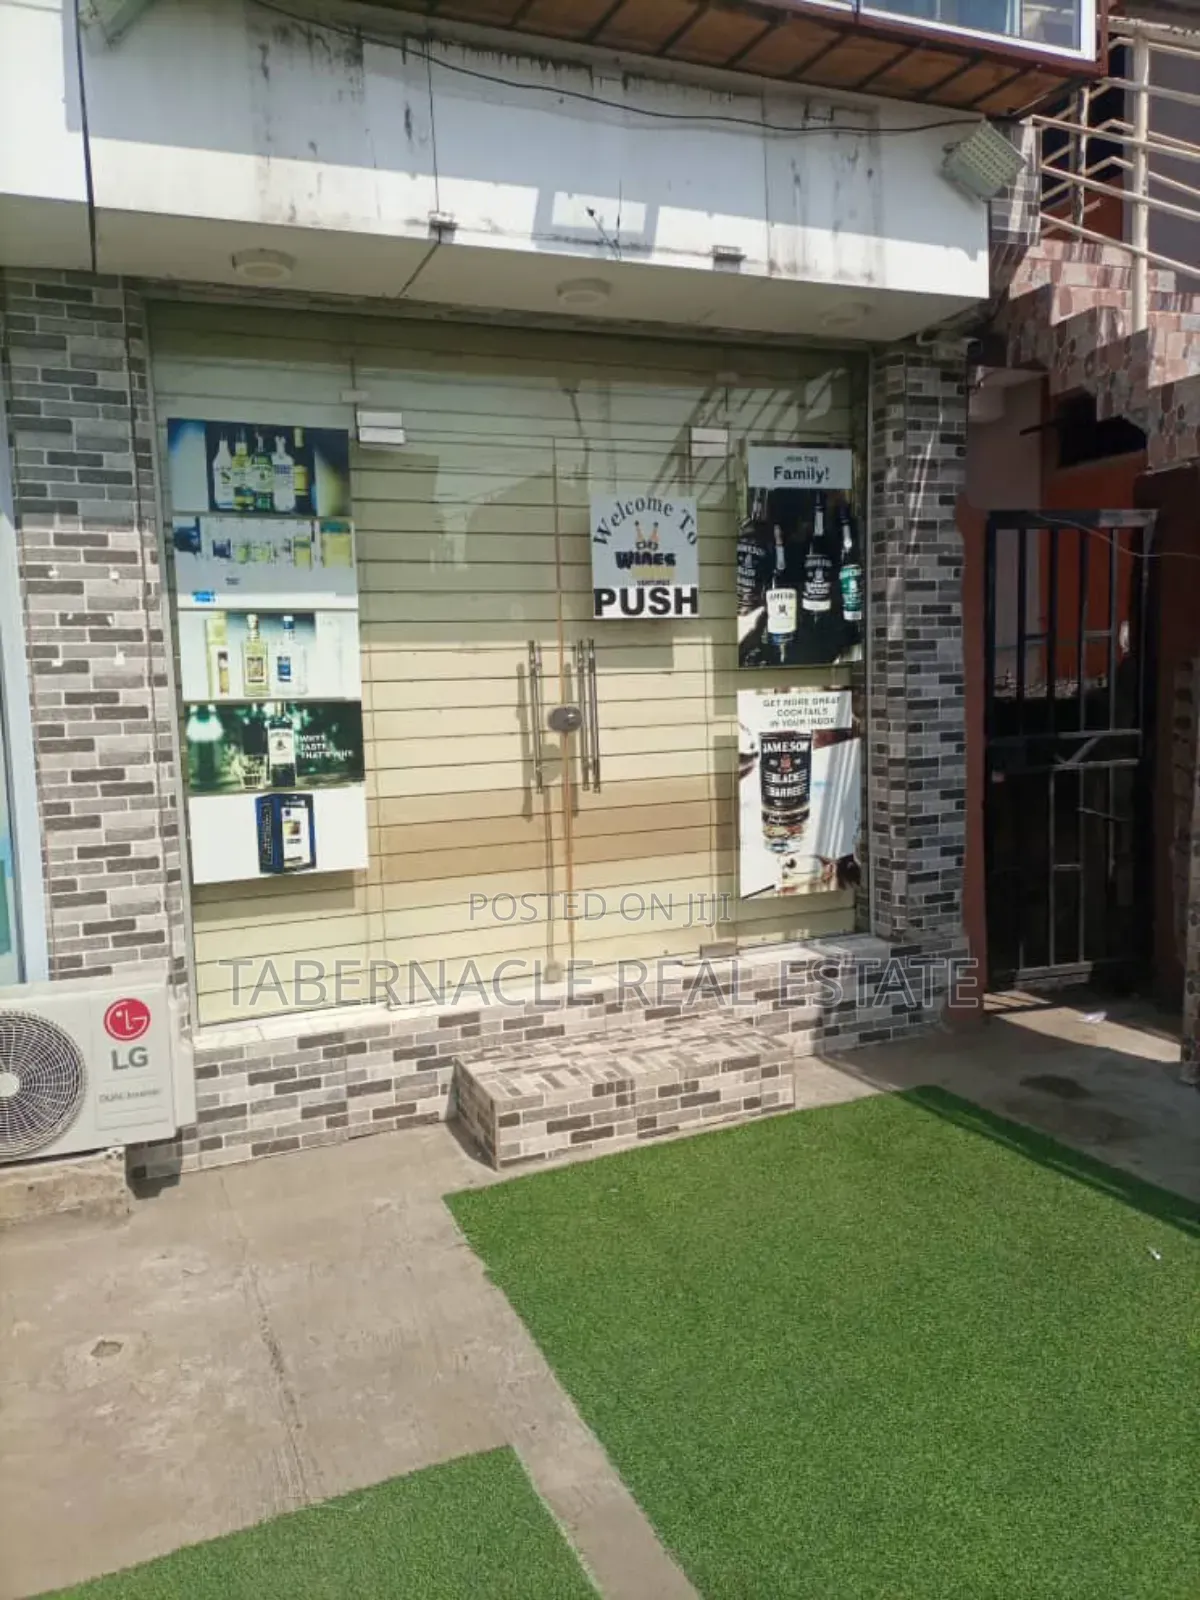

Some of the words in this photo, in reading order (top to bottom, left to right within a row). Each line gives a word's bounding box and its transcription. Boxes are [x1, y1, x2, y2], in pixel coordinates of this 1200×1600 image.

[774, 465, 830, 484] Family!
[593, 497, 674, 544] Welcome
[680, 509, 697, 545] To
[594, 587, 698, 616] PUSH
[762, 741, 809, 753] JAMESON
[111, 1046, 149, 1070] LG
